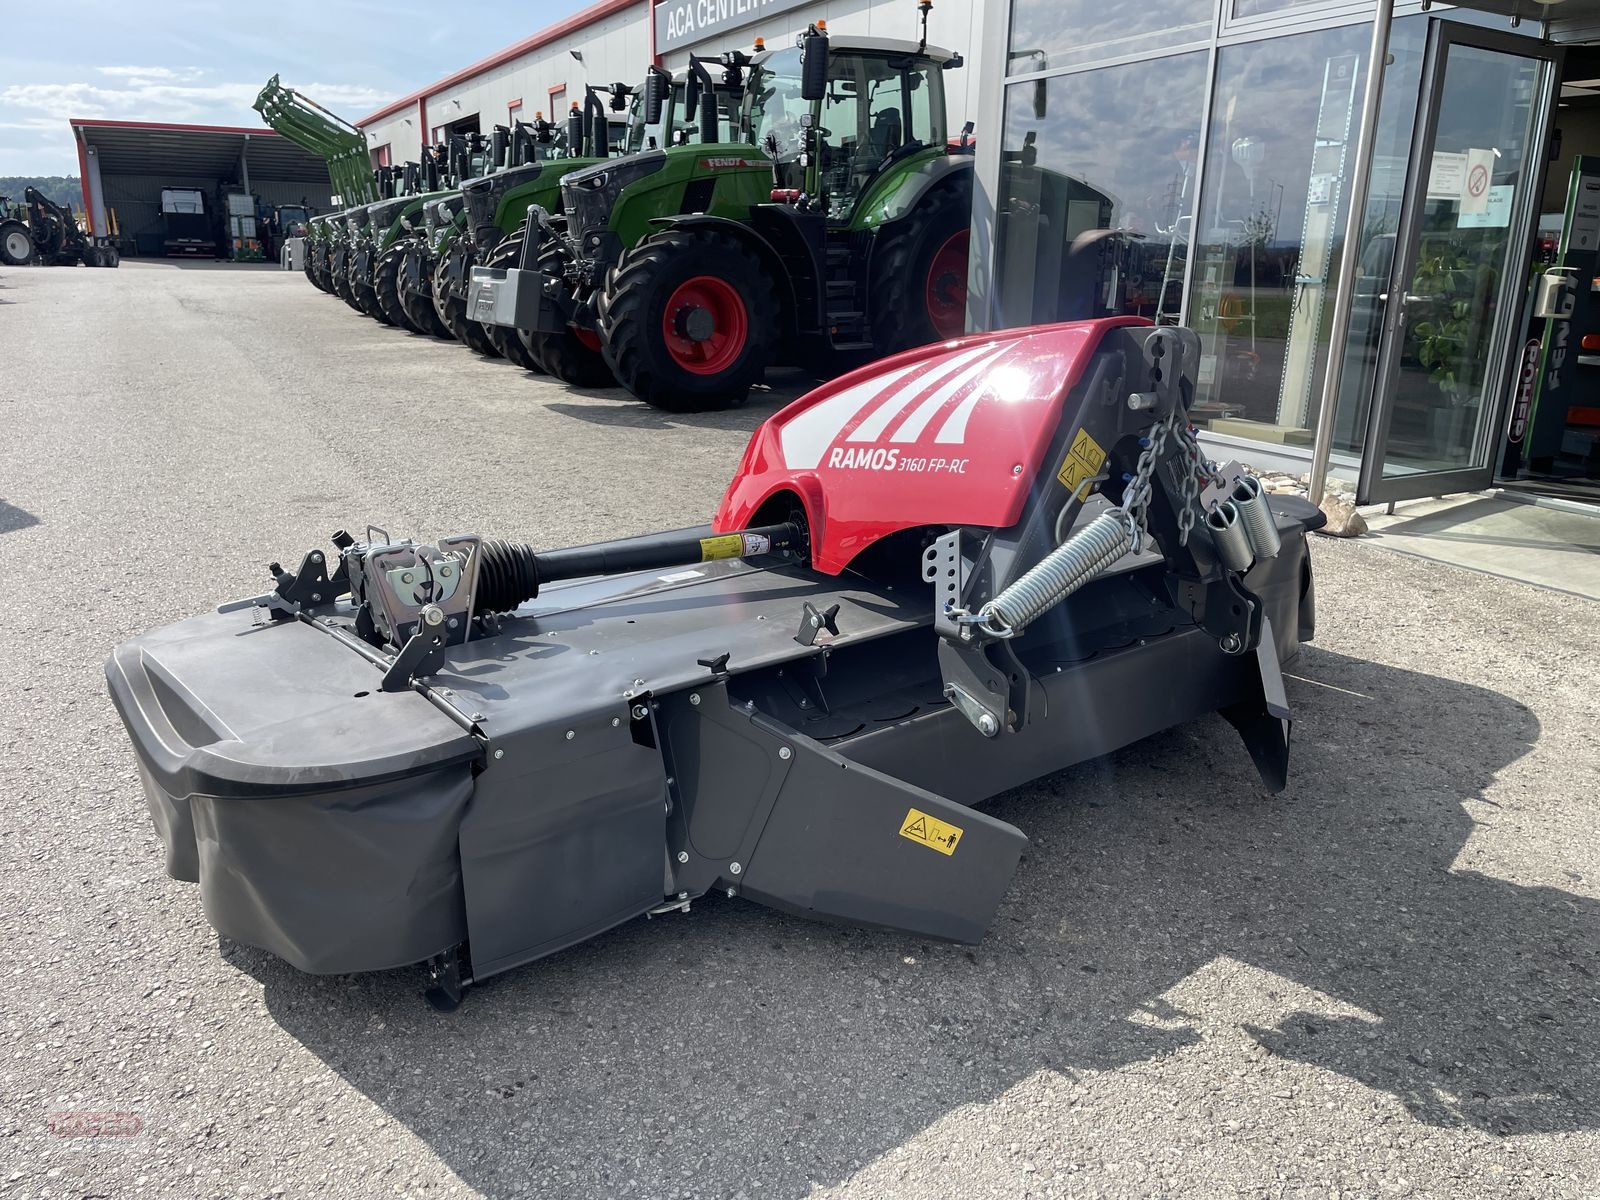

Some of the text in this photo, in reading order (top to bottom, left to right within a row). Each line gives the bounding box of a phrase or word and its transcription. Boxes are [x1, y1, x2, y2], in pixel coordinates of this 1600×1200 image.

[667, 3, 695, 40] ACA
[707, 158, 742, 167] FENDT
[828, 447, 970, 474] RAMOS 3160 FP-RC
